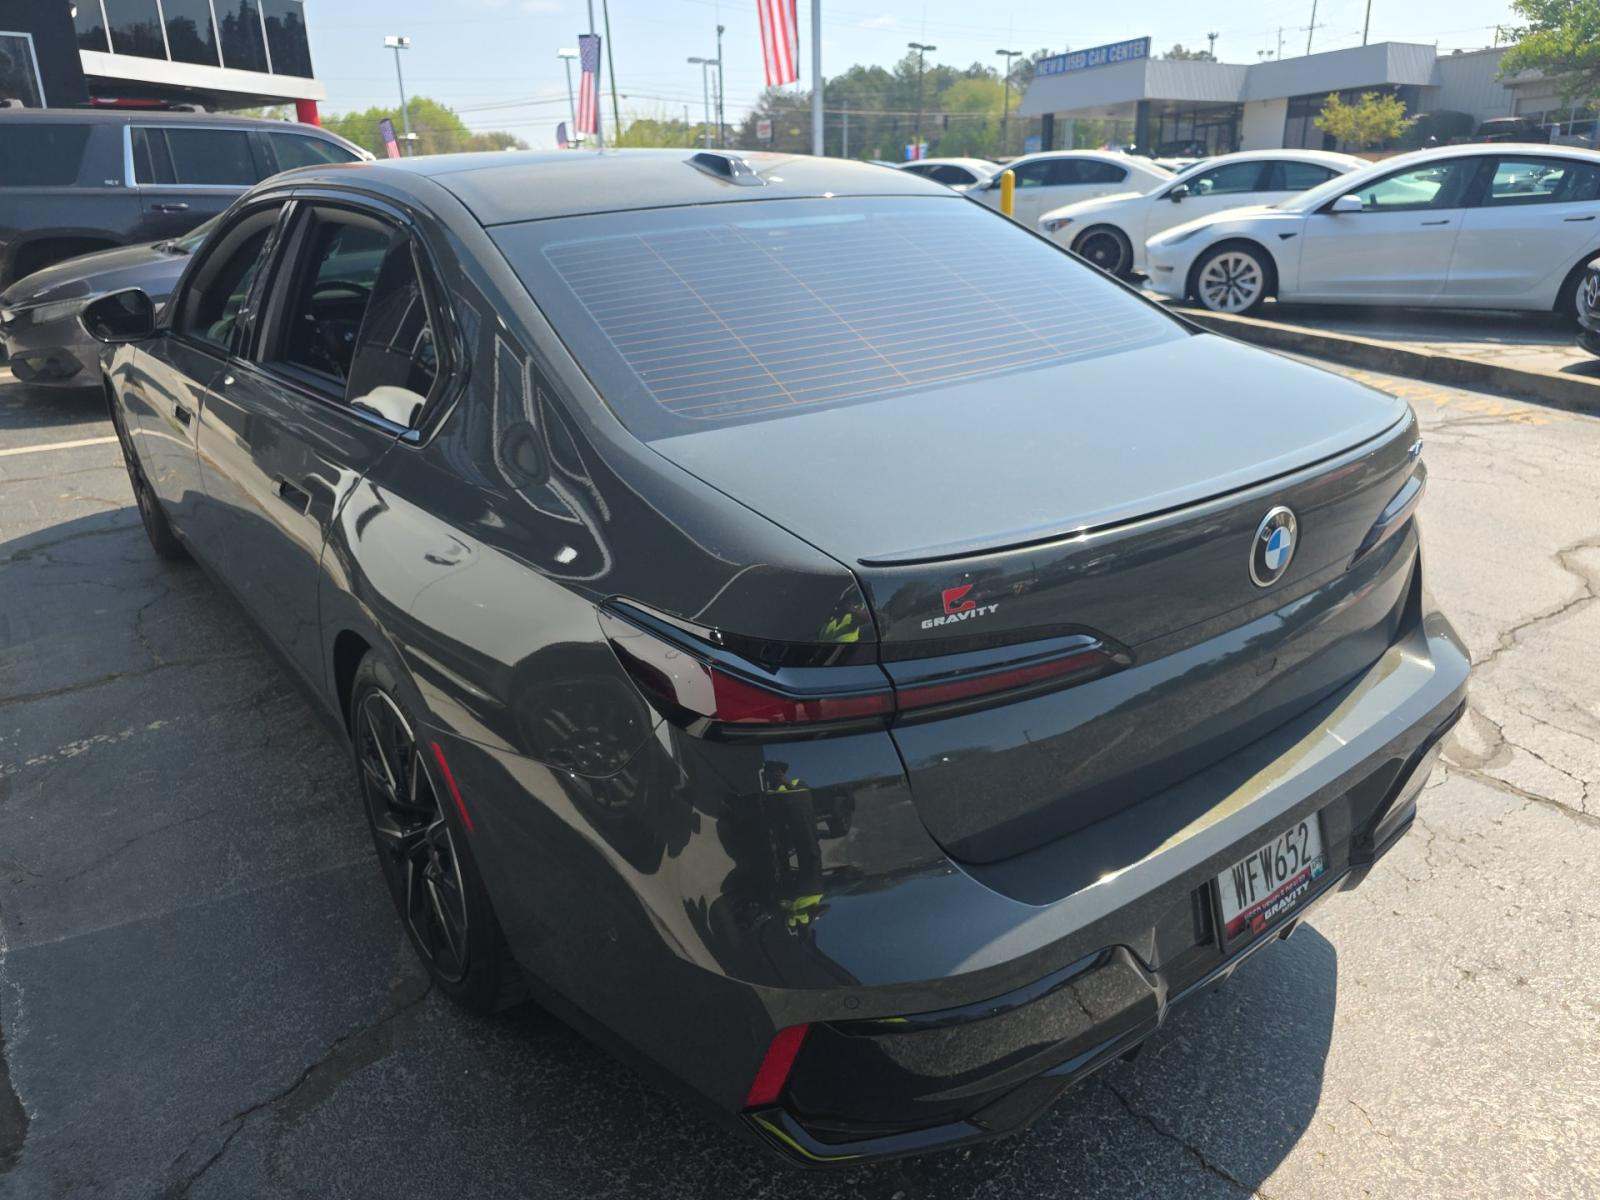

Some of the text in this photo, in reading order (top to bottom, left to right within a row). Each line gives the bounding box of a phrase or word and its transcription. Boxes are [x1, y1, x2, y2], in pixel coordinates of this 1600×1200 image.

[1065, 53, 1087, 71] USED
[1088, 48, 1107, 66] CAR
[1108, 41, 1146, 63] CENTER
[921, 603, 999, 630] GRAVITY
[1231, 822, 1311, 910] WFW652
[1264, 881, 1310, 920] GRAVITY
